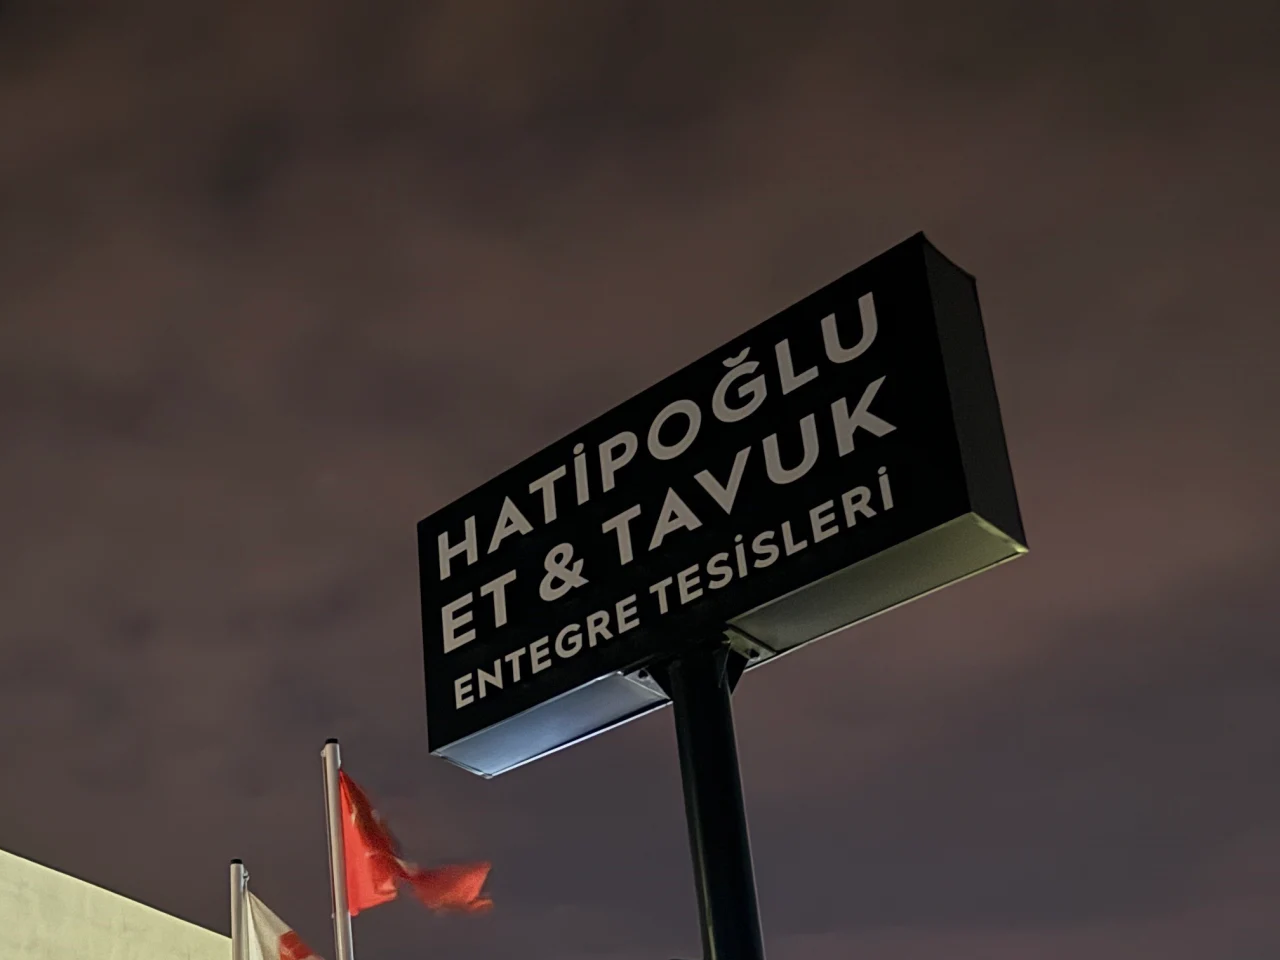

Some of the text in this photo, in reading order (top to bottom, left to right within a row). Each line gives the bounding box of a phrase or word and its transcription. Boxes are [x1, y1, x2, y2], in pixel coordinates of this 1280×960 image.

[437, 291, 879, 581] HATİPOĞLU
[441, 375, 897, 654] ET & TAVUK
[453, 465, 895, 710] ENTEGRE TESİSLERİ
